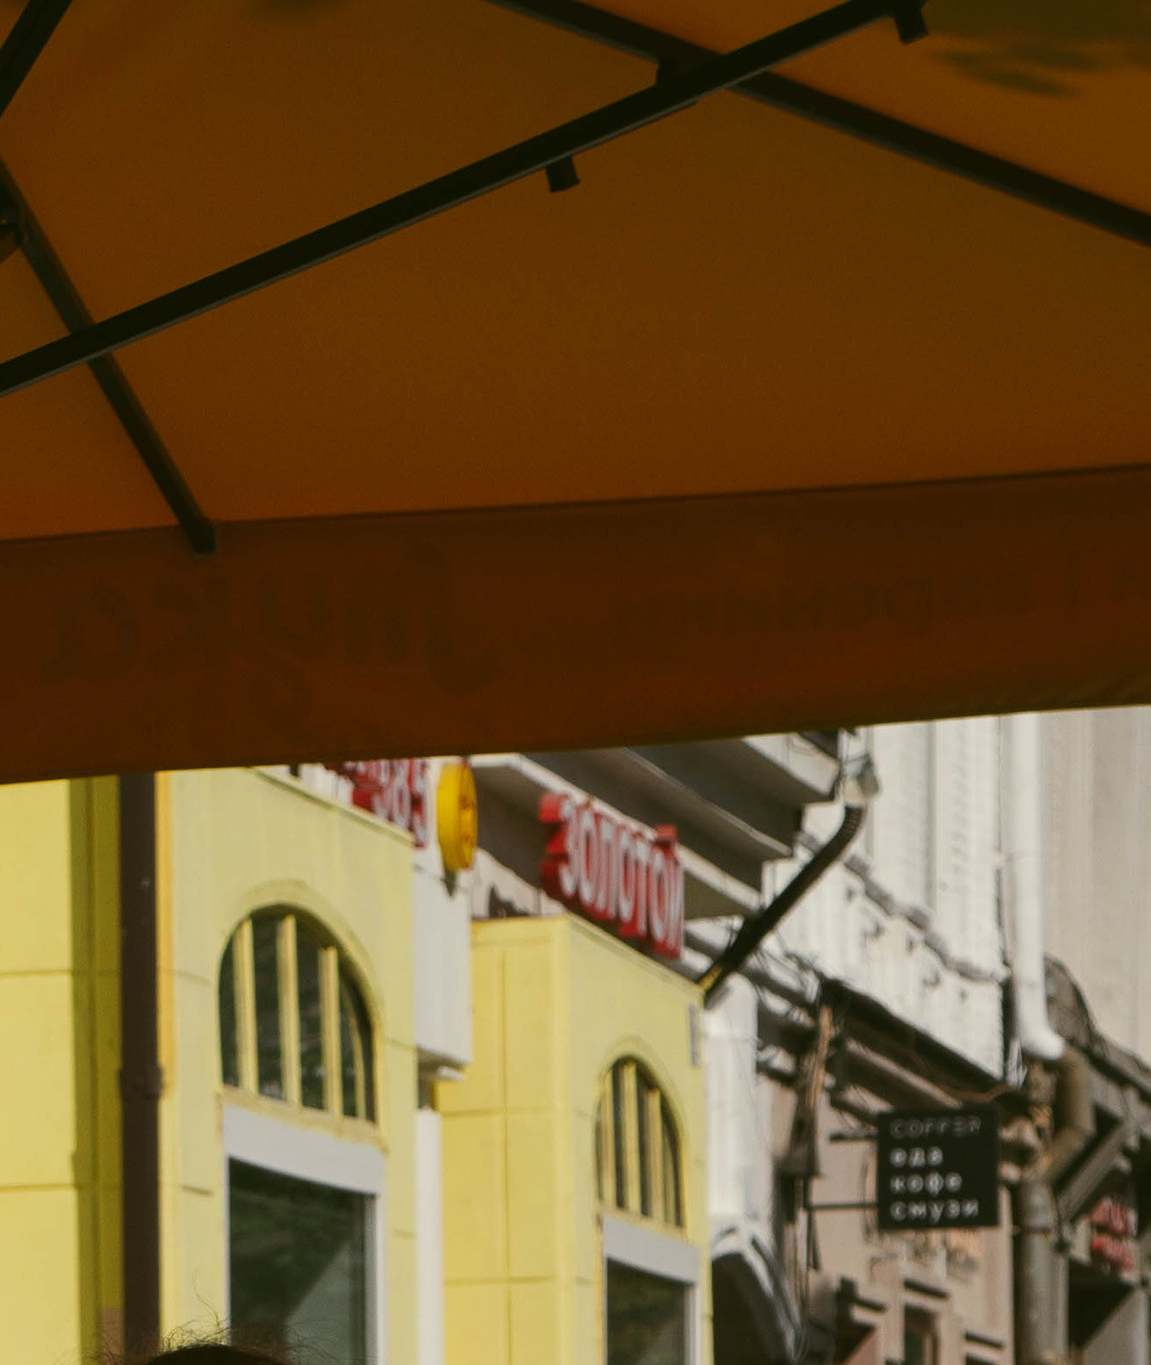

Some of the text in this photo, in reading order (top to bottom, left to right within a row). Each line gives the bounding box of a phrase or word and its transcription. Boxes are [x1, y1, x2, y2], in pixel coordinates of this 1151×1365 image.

[541, 792, 685, 958] ЗОЛОТОЙ
[891, 1147, 943, 1168] еда
[891, 1172, 963, 1196] кофе
[891, 1200, 979, 1223] смузи
